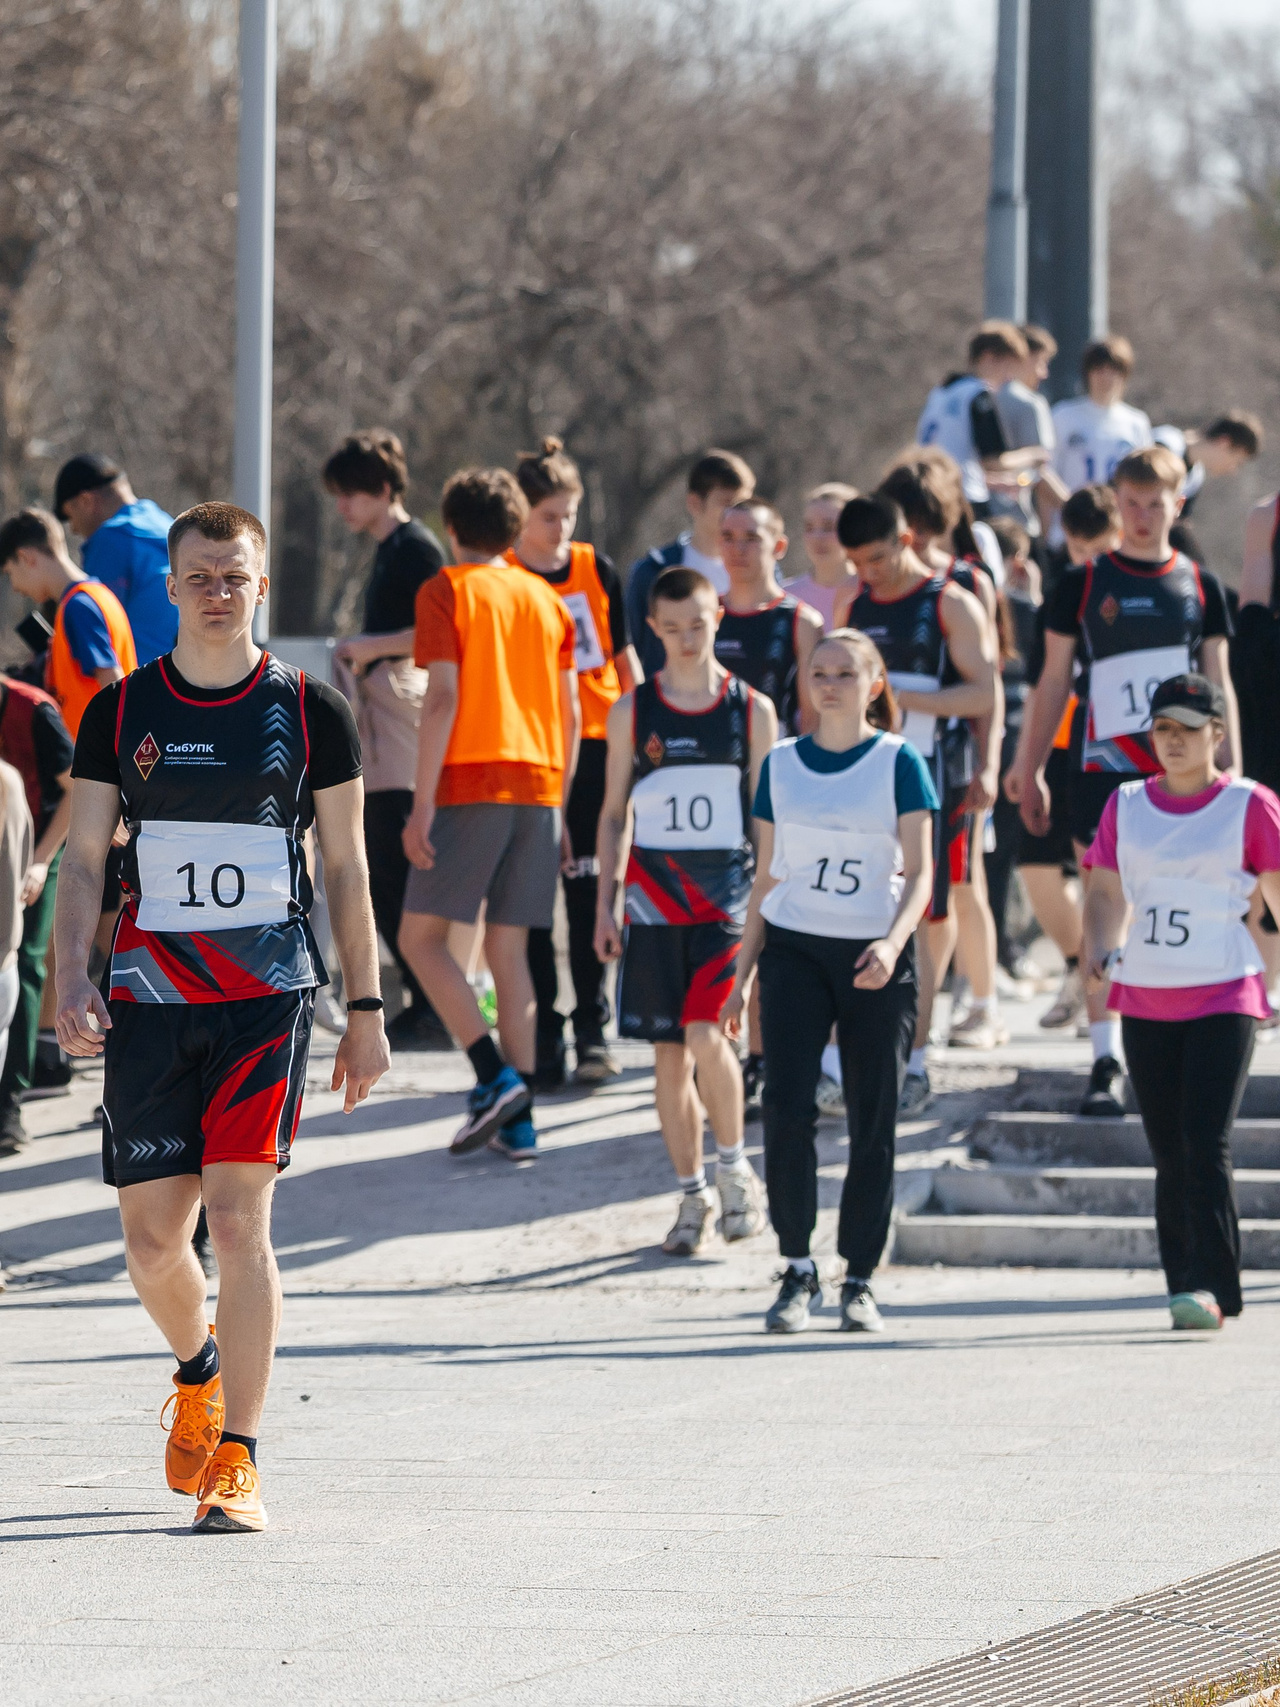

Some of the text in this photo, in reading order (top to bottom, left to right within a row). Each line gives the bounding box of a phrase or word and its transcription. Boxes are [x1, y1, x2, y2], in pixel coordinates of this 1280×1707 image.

[165, 742, 215, 753] СибУПК
[665, 796, 713, 832] 10
[176, 861, 245, 909] 10
[810, 857, 862, 896] 15
[1144, 907, 1190, 947] 15
